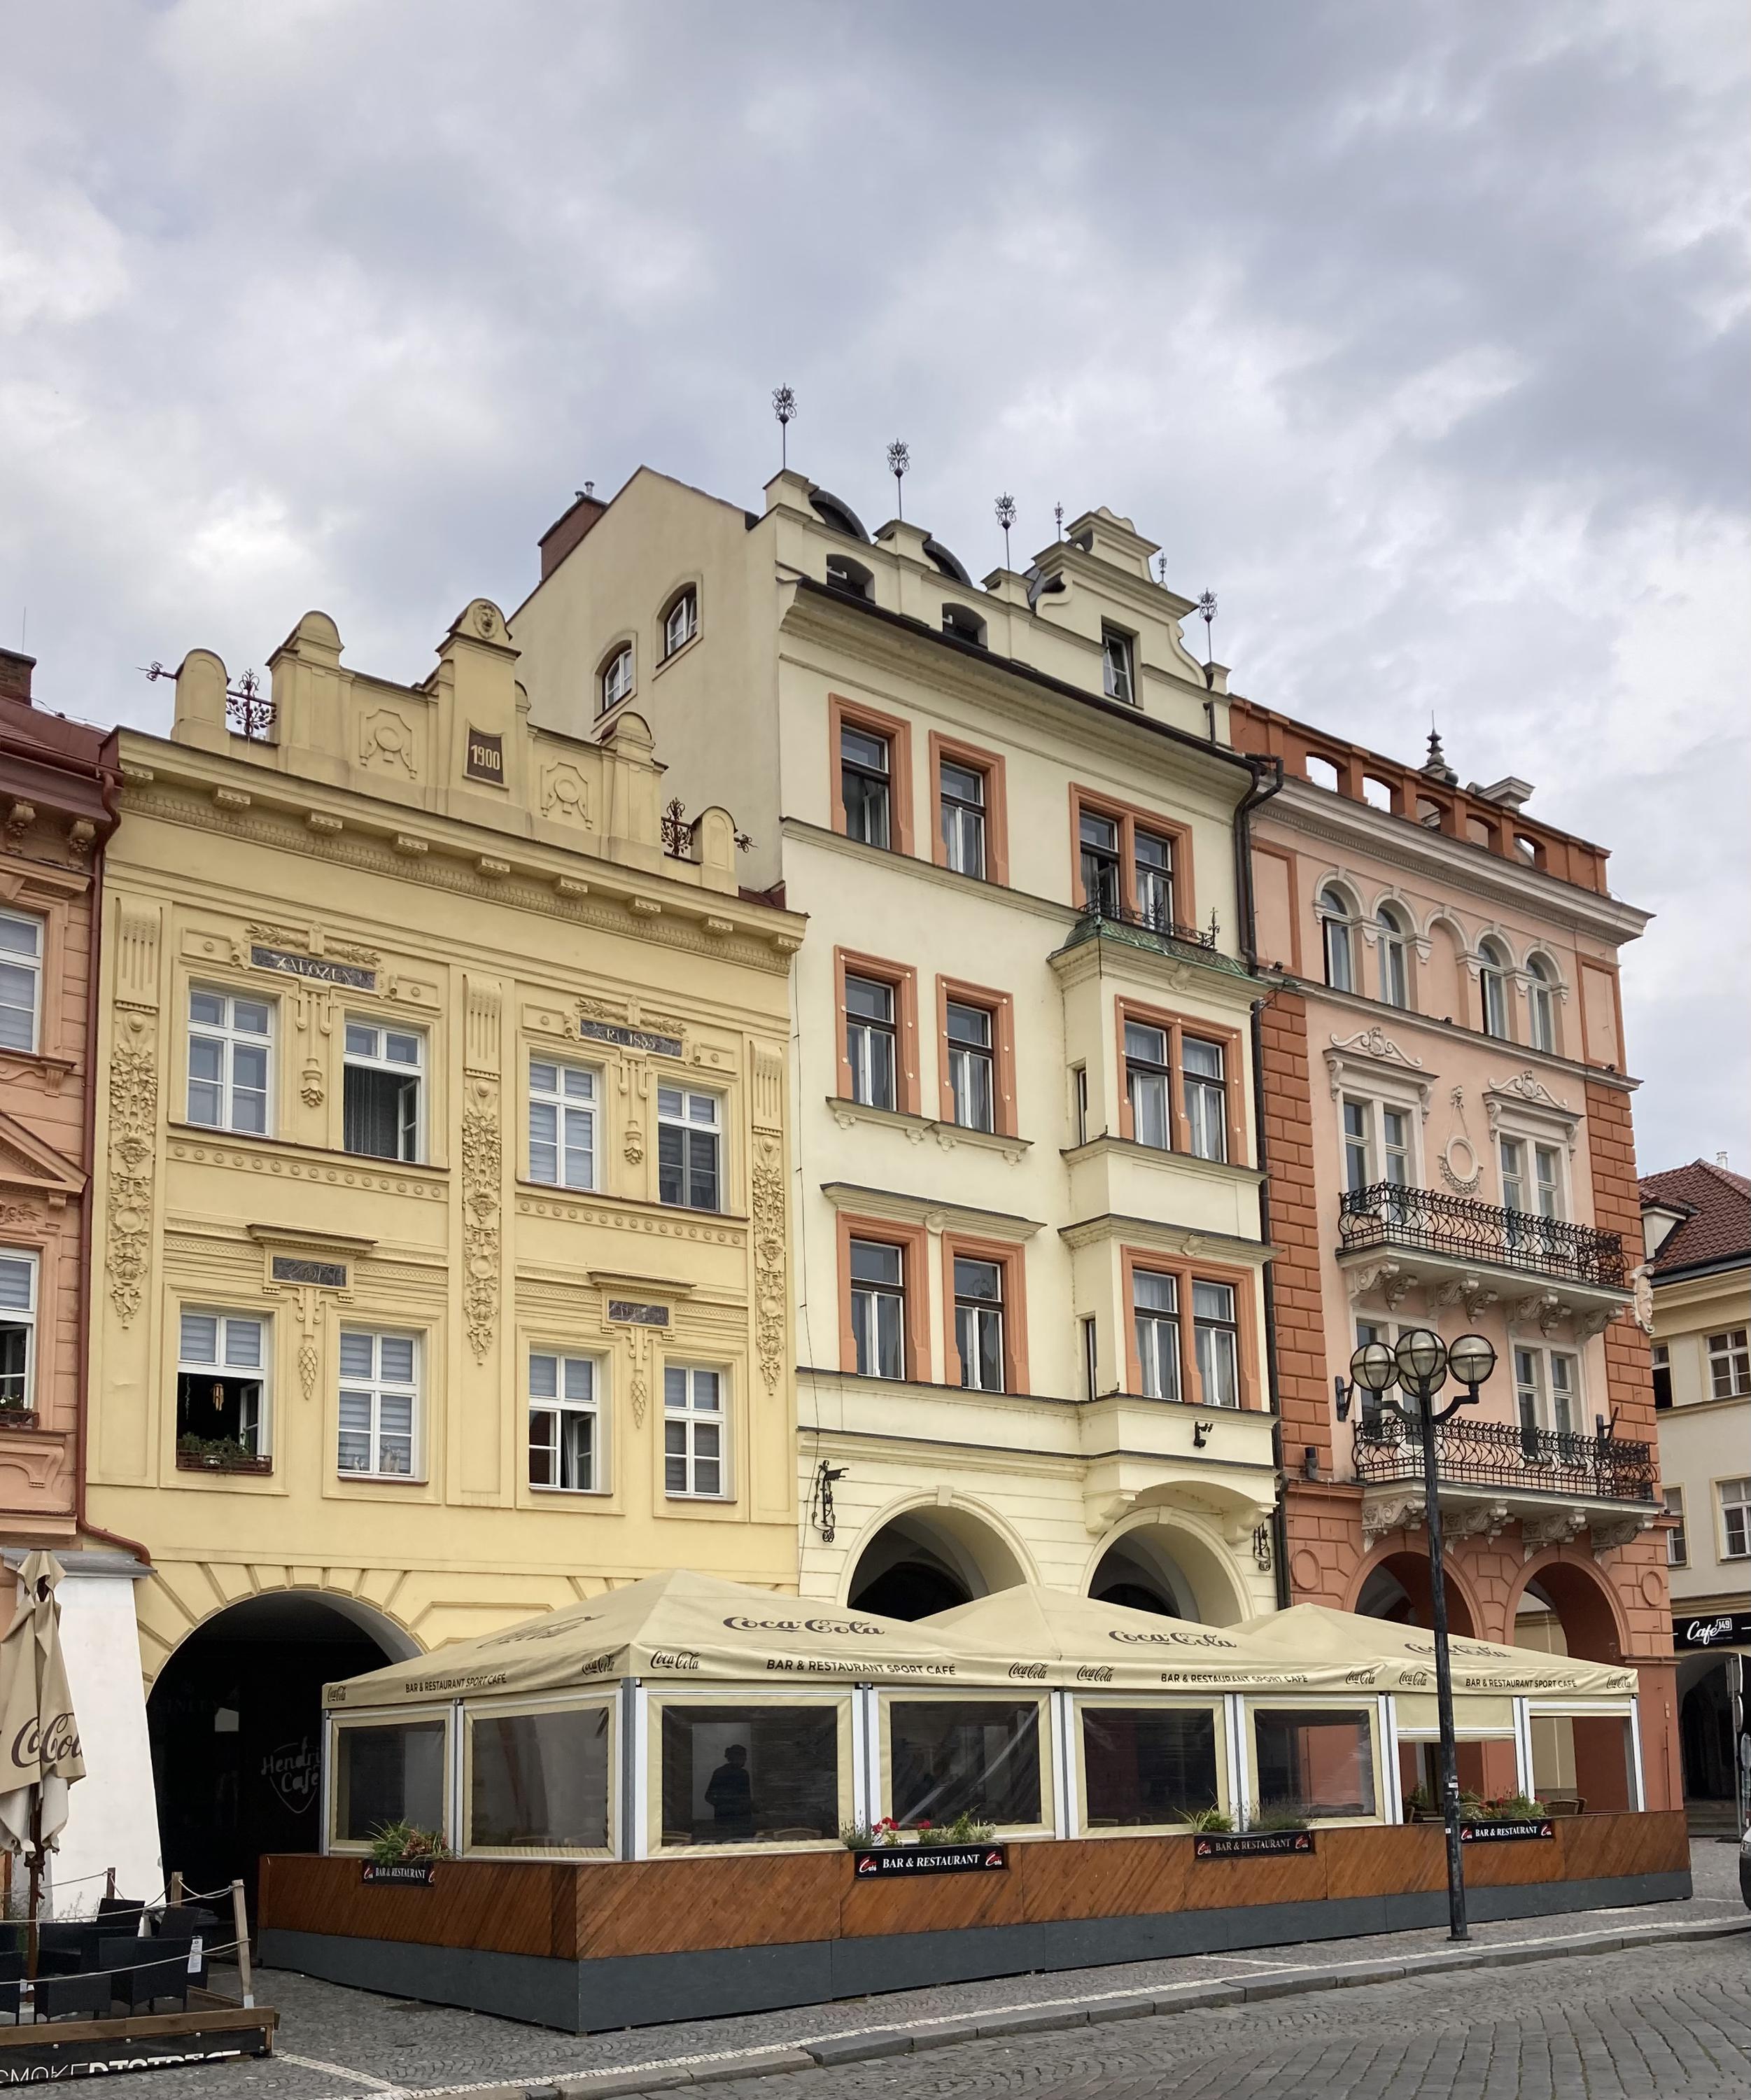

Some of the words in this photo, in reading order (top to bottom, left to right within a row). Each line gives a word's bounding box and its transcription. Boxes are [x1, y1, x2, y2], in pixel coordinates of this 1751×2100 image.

[470, 744, 500, 771] 1900
[723, 1616, 885, 1634] Coca-Cola
[1687, 1620, 1719, 1644] Café
[1109, 1630, 1237, 1648] Coca-Cola
[650, 1651, 701, 1670] Coca-Cola
[766, 1659, 793, 1670] BAR
[796, 1660, 805, 1670] &
[808, 1660, 883, 1672] RESTAURANT
[887, 1665, 923, 1674] SPORT
[927, 1663, 956, 1675] CAFÉ
[1008, 1662, 1048, 1679] Coca-Cola
[1076, 1665, 1116, 1682] Coca-Cola
[1161, 1674, 1180, 1682] BAR
[1190, 1674, 1249, 1683] RESTAURANT
[1399, 1671, 1428, 1686] Coca-Cola
[406, 1684, 418, 1693] BAR
[419, 1683, 423, 1691] &
[425, 1679, 465, 1690] RESTAURANT
[465, 1676, 488, 1687] SPORT
[1465, 1678, 1481, 1686] BAR
[1489, 1679, 1533, 1688] RESTAURANT
[261, 1736, 321, 1775] Hendri
[1475, 1828, 1489, 1837] BAR
[1497, 1826, 1538, 1835] RESTAURANT
[1216, 1842, 1232, 1851] BAR
[1233, 1842, 1240, 1850] &
[1242, 1838, 1291, 1849] RESTAURANT
[882, 1858, 903, 1868] BAR
[906, 1858, 914, 1867] &
[916, 1854, 980, 1867] RESTAURANT
[376, 1868, 386, 1876] BAR
[391, 1868, 426, 1879] RESTAURANT
